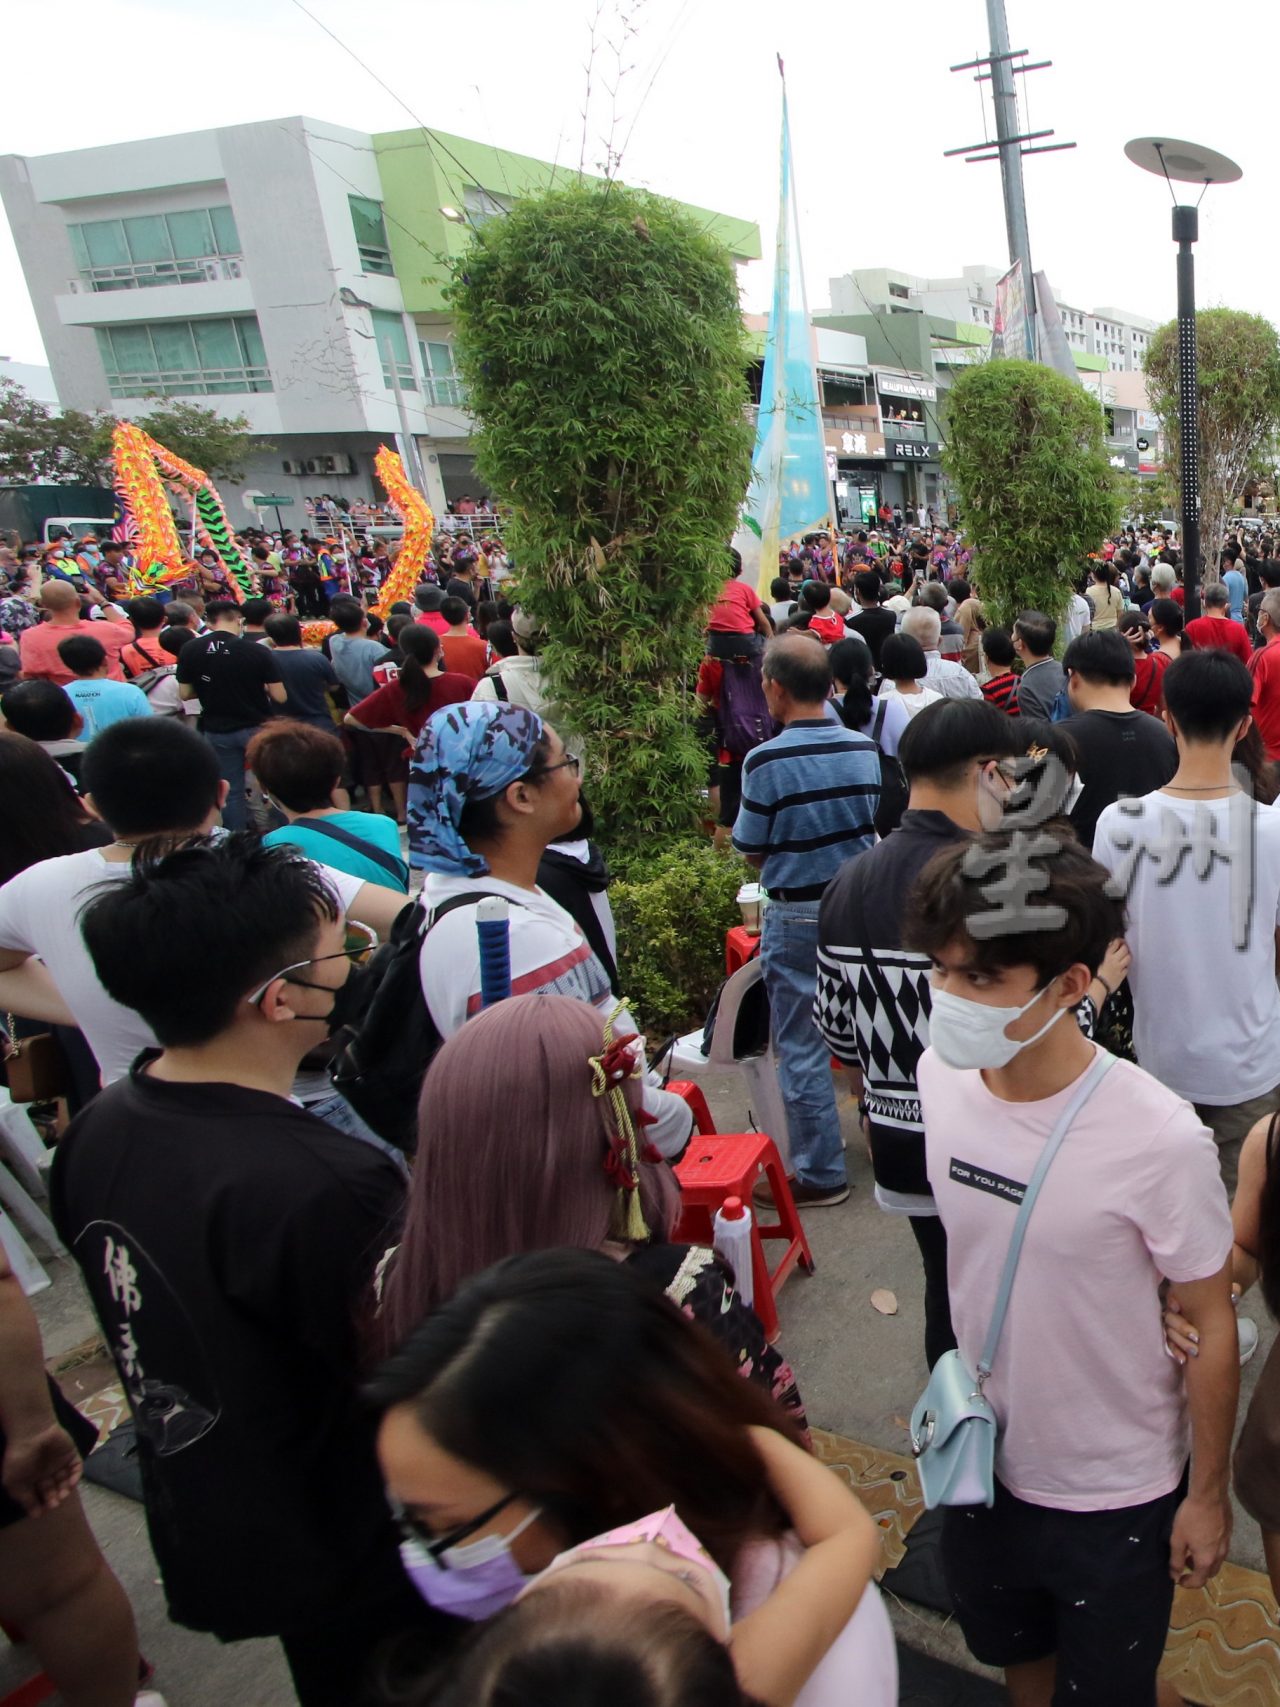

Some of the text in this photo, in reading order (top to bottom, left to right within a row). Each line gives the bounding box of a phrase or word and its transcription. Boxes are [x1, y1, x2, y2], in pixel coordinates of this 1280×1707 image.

[896, 444, 930, 457] RELX
[951, 1166, 1024, 1199] FOR YOU PAGE
